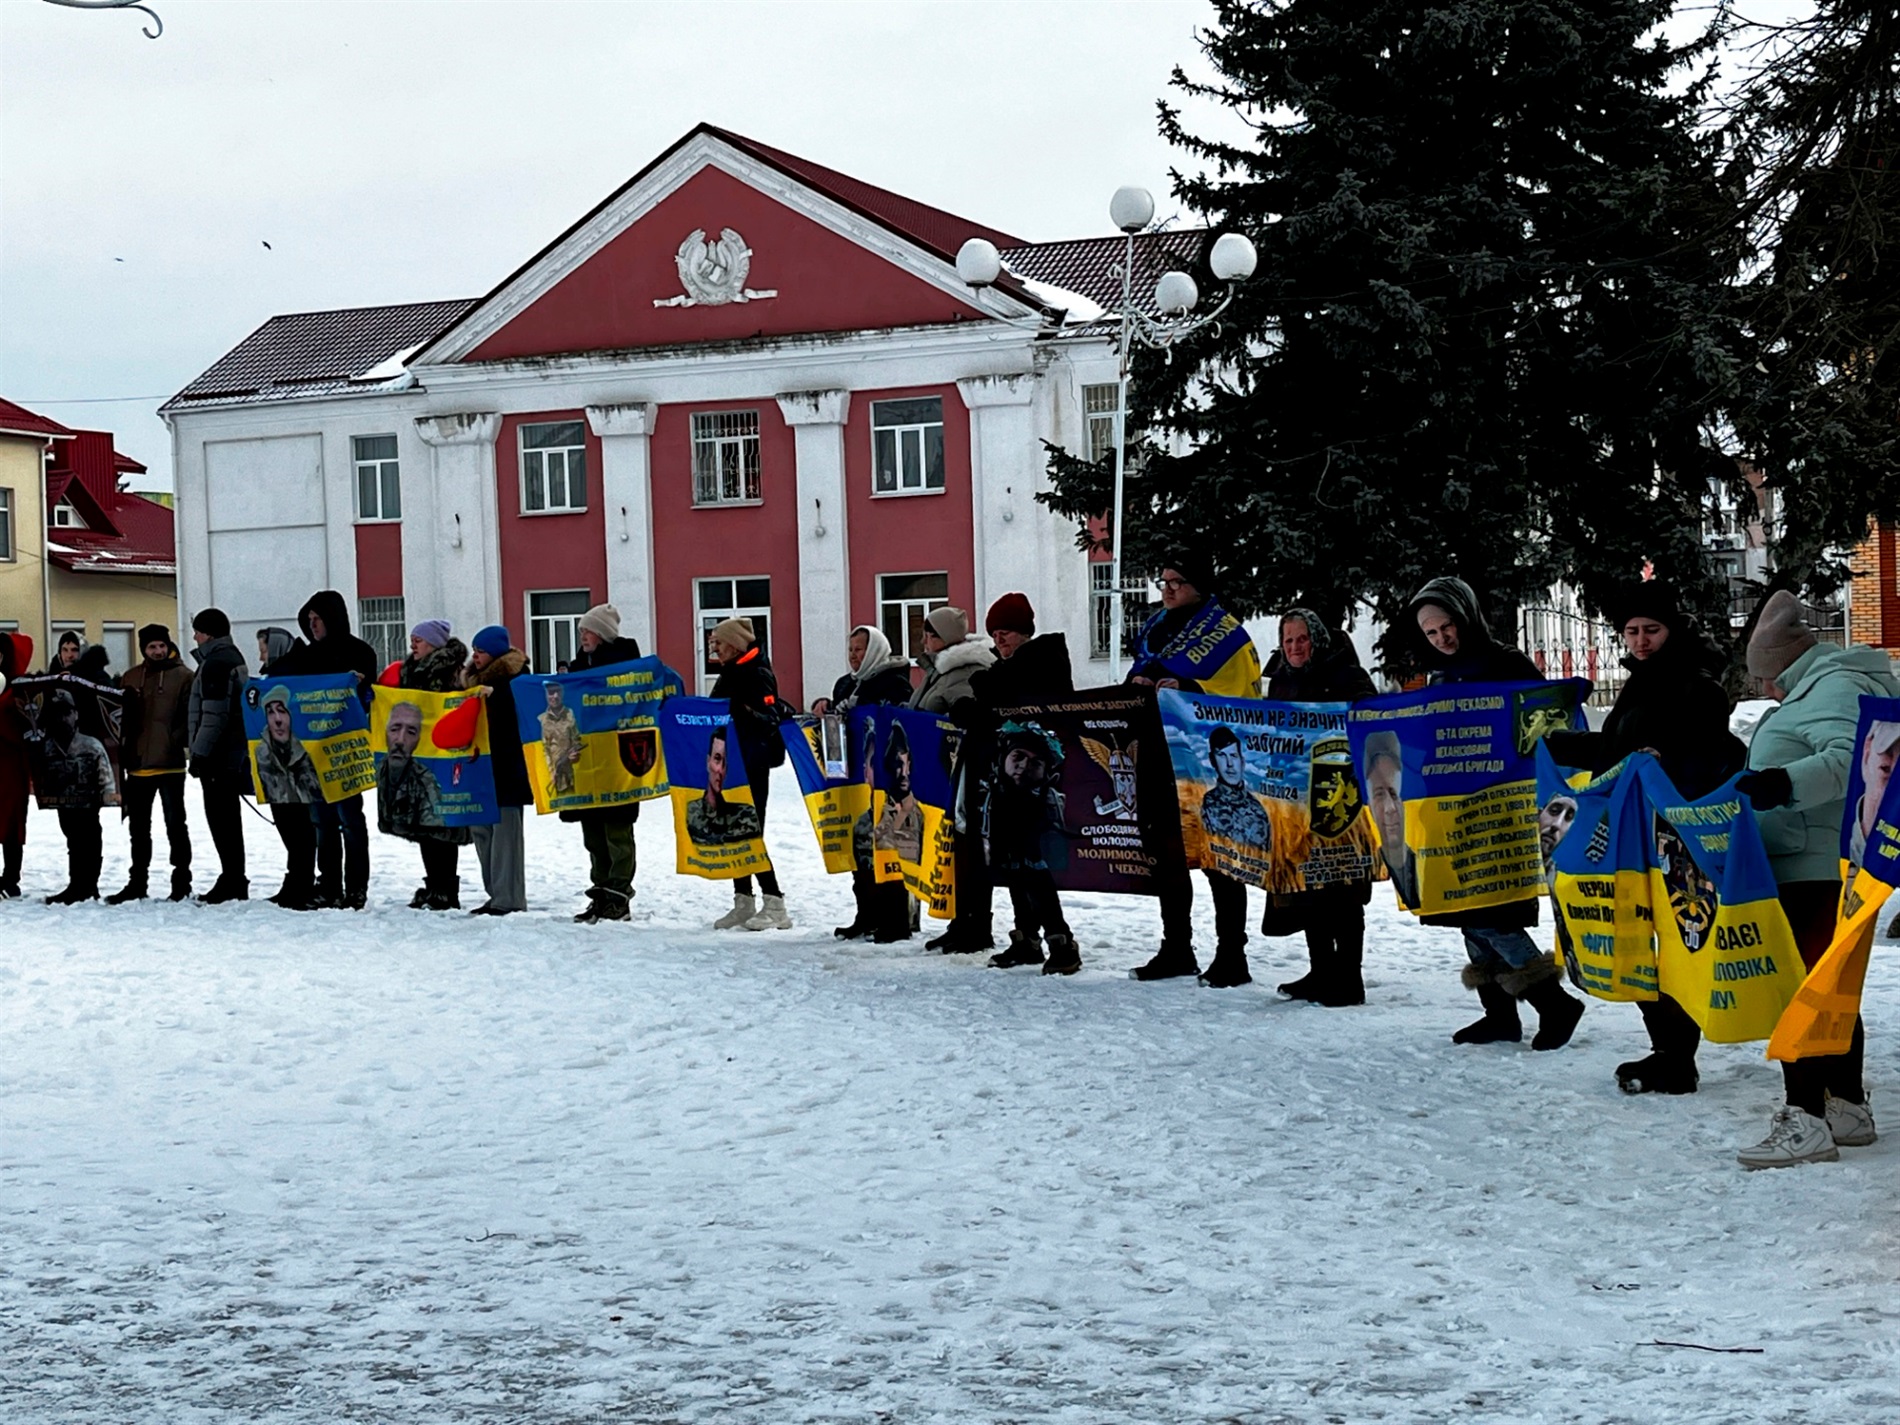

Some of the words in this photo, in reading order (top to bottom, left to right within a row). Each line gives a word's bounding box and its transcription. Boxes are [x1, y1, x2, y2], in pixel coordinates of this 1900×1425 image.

[1268, 709, 1285, 727] не
[332, 737, 369, 753] ОКРЕМА
[1245, 733, 1305, 756] забутий
[1684, 918, 1700, 950] 56
